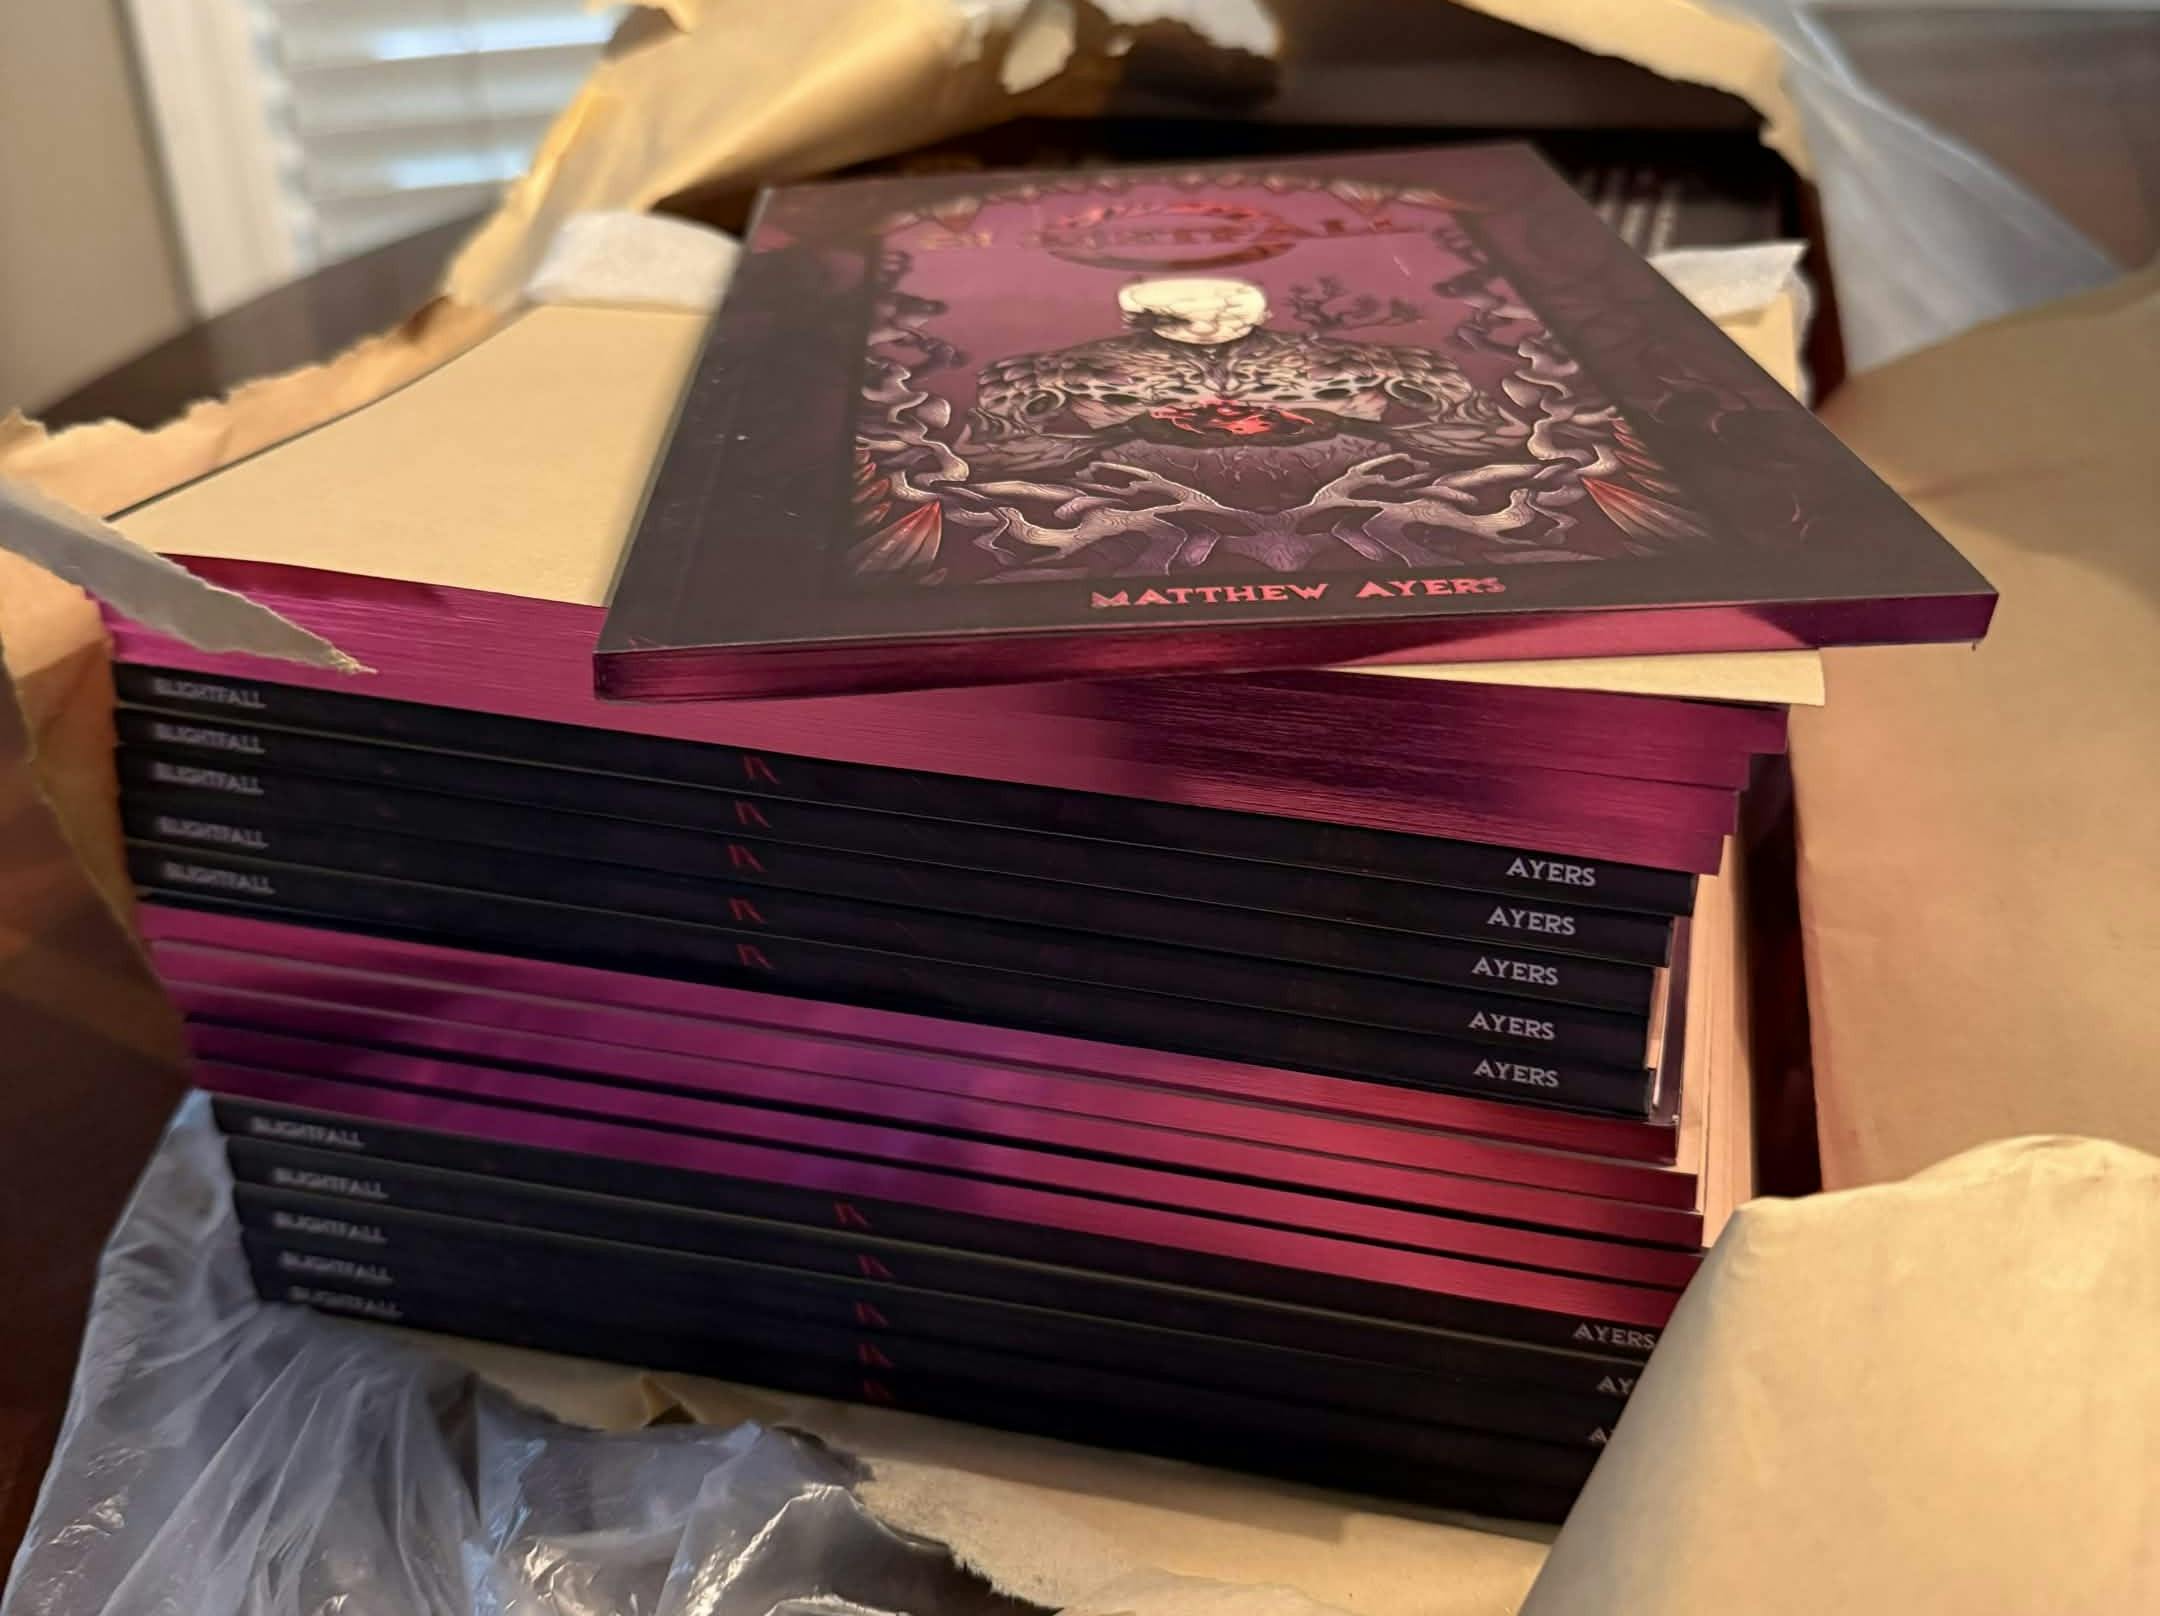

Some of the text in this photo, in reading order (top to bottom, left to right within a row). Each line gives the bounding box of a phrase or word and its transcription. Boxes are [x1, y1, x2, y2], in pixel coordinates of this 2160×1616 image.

[1091, 576, 1506, 608] MATTHEW AYERS
[1506, 856, 1596, 888] AYERS
[1487, 906, 1576, 936] AYERS
[1471, 956, 1559, 987] AYERS
[1467, 1011, 1555, 1041] AYERS
[1473, 1058, 1560, 1088] AYERS
[1574, 1323, 1656, 1349] AYERS
